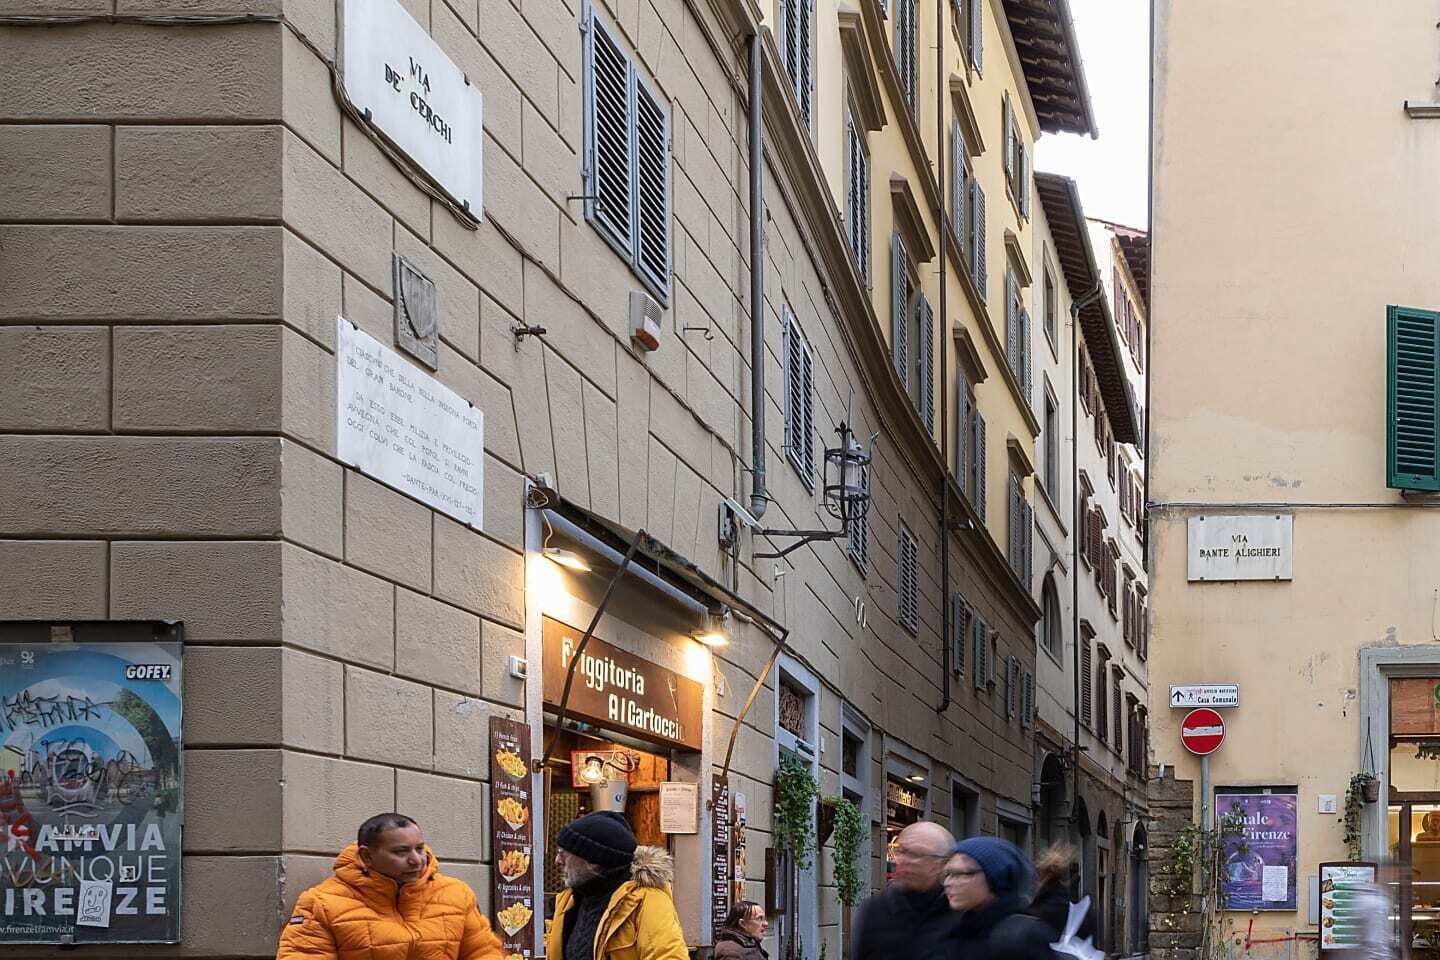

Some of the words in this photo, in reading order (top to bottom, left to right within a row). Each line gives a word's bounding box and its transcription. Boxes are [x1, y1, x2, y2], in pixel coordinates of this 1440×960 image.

[408, 56, 430, 92] VIA
[384, 63, 404, 93] DE'
[410, 91, 452, 144] CERCHI
[1200, 549, 1229, 558] DANTE
[1235, 548, 1280, 558] ALIGHIERI
[1231, 535, 1248, 543] VIA
[1197, 696, 1210, 704] Casa
[1212, 695, 1237, 703] Comunale
[0, 823, 166, 852] RAMVIA
[1241, 827, 1290, 840] Firenze
[0, 855, 167, 884] VUNQUE
[4, 886, 167, 916] IREZE
